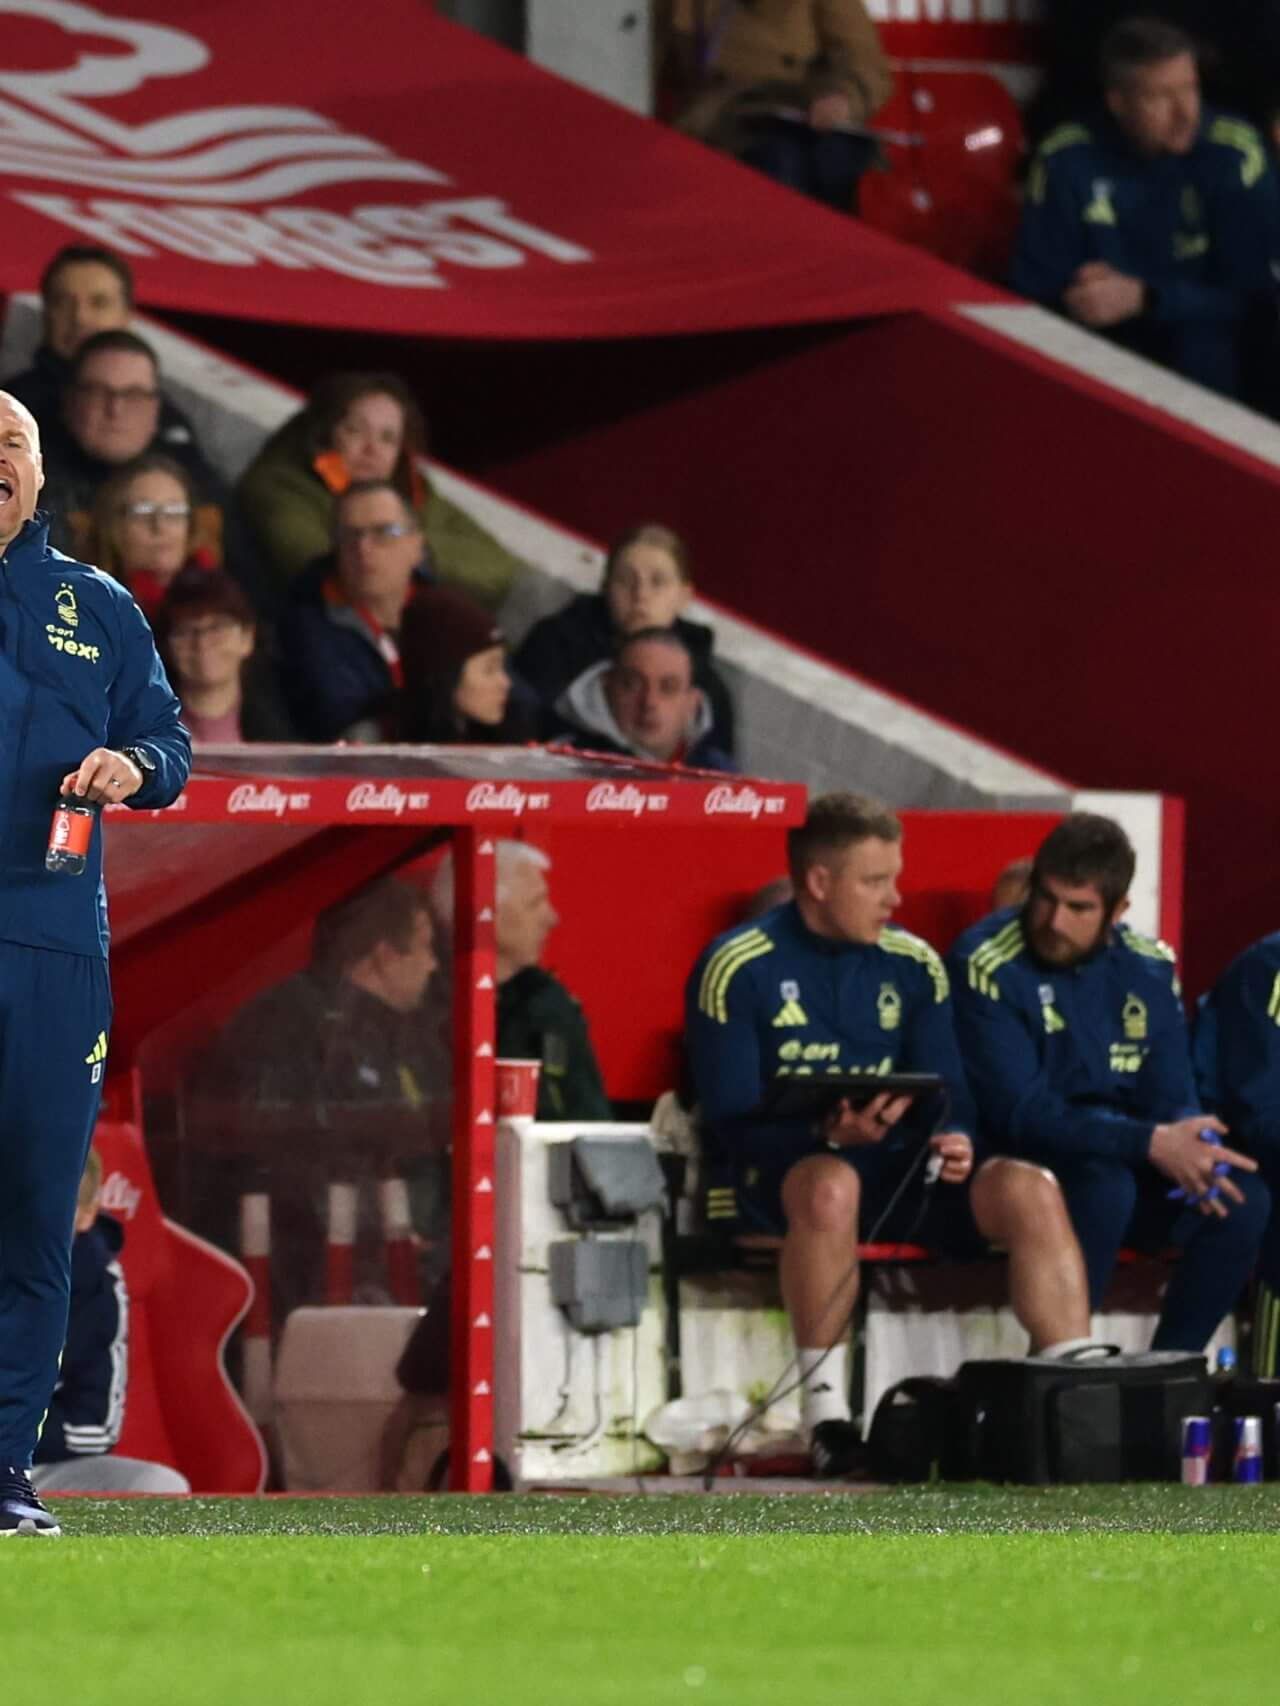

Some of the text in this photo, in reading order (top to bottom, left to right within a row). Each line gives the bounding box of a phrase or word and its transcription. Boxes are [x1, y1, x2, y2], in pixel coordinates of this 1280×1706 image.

[48, 634, 100, 664] next
[227, 783, 288, 816] Bally
[346, 782, 407, 816] Bally
[466, 782, 526, 816] Bally
[586, 783, 646, 817] Bally
[704, 785, 763, 819] Bally
